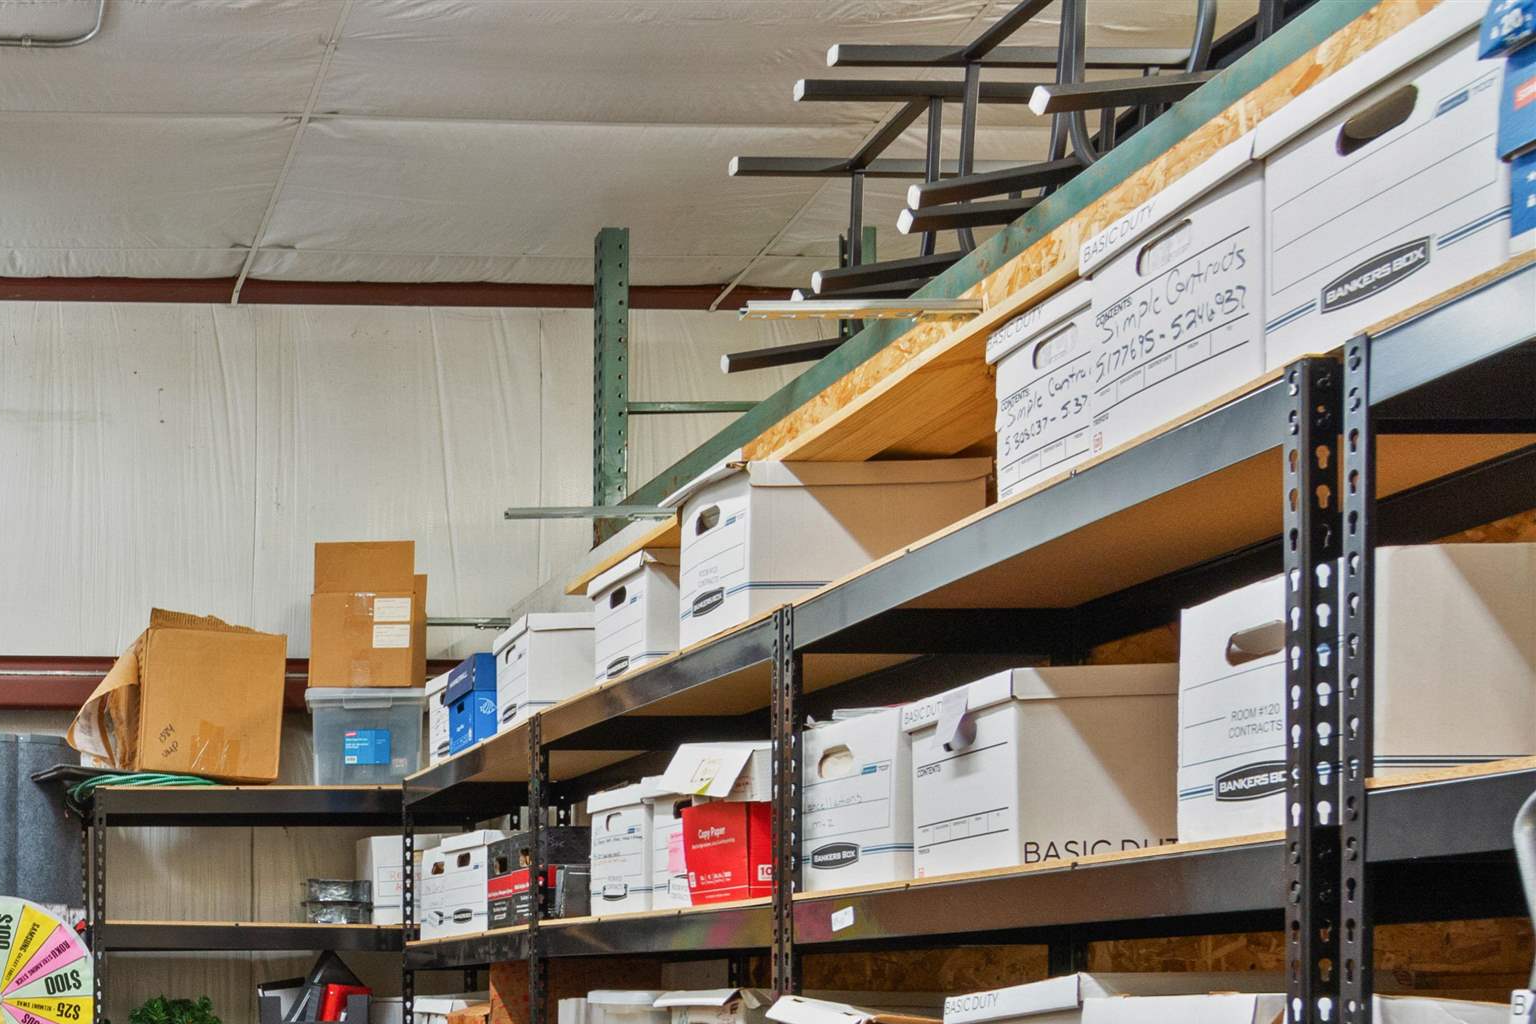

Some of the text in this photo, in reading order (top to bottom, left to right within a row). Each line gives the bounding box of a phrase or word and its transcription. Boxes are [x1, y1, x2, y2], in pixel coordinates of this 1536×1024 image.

[1083, 202, 1156, 263] BASIC DUTY
[1326, 246, 1425, 304] BANKERS BOX
[1230, 702, 1280, 722] ROOM #120
[1227, 718, 1283, 739] CONTRACTS
[1219, 771, 1270, 793] BANKERS
[814, 850, 856, 863] BANKERS BOX
[50, 940, 71, 960] ROKU
[44, 969, 82, 995] $100
[56, 1002, 81, 1020] $25
[944, 993, 999, 1015] BASIC DUTY
